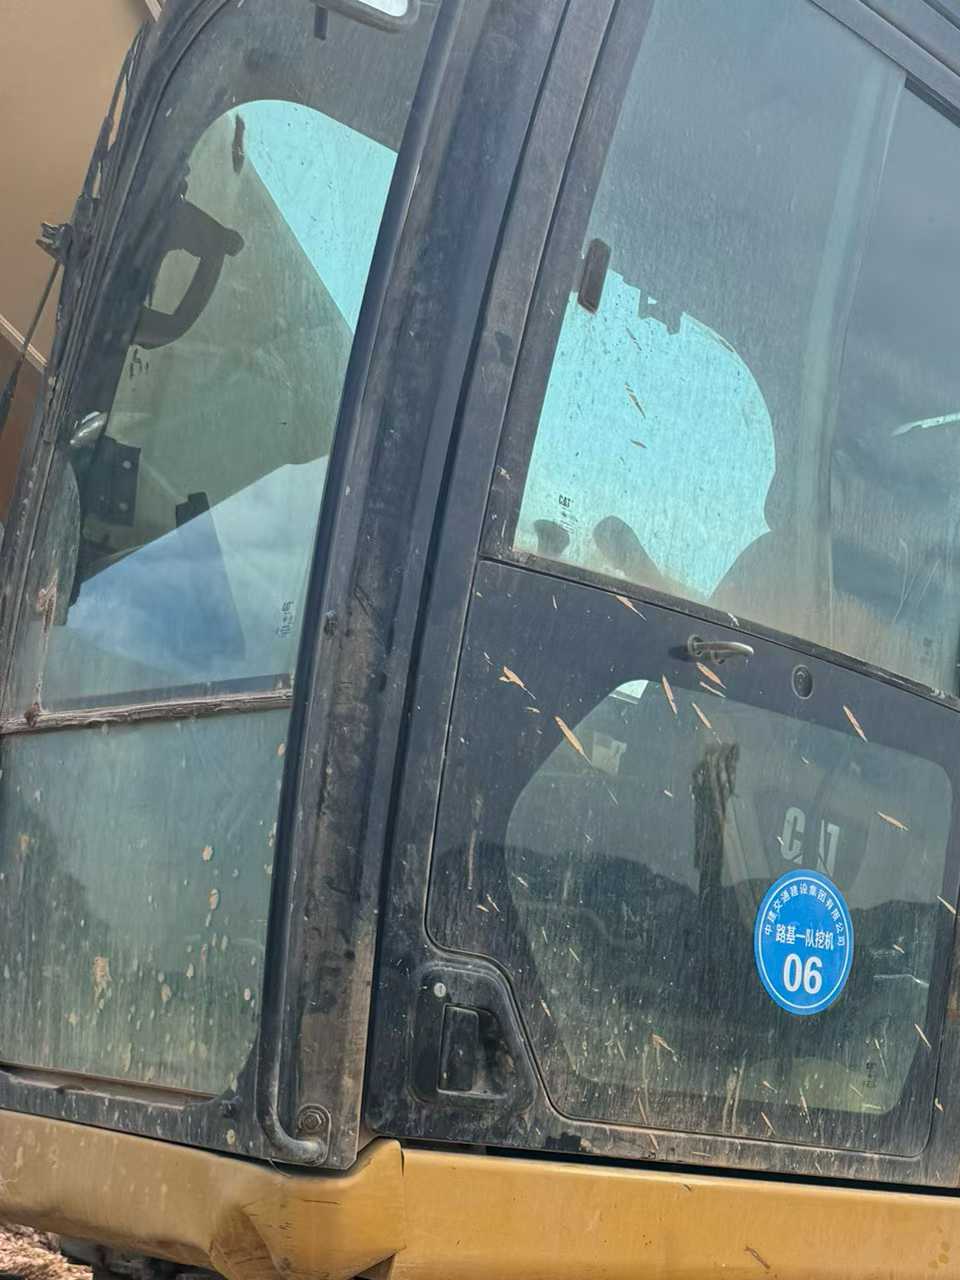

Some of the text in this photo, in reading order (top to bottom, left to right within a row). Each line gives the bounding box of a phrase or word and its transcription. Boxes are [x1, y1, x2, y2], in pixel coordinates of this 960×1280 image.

[764, 882, 845, 946] 中建交通建设集团有限公司
[775, 923, 834, 951] 路基一队挖机
[783, 953, 823, 995] 06
